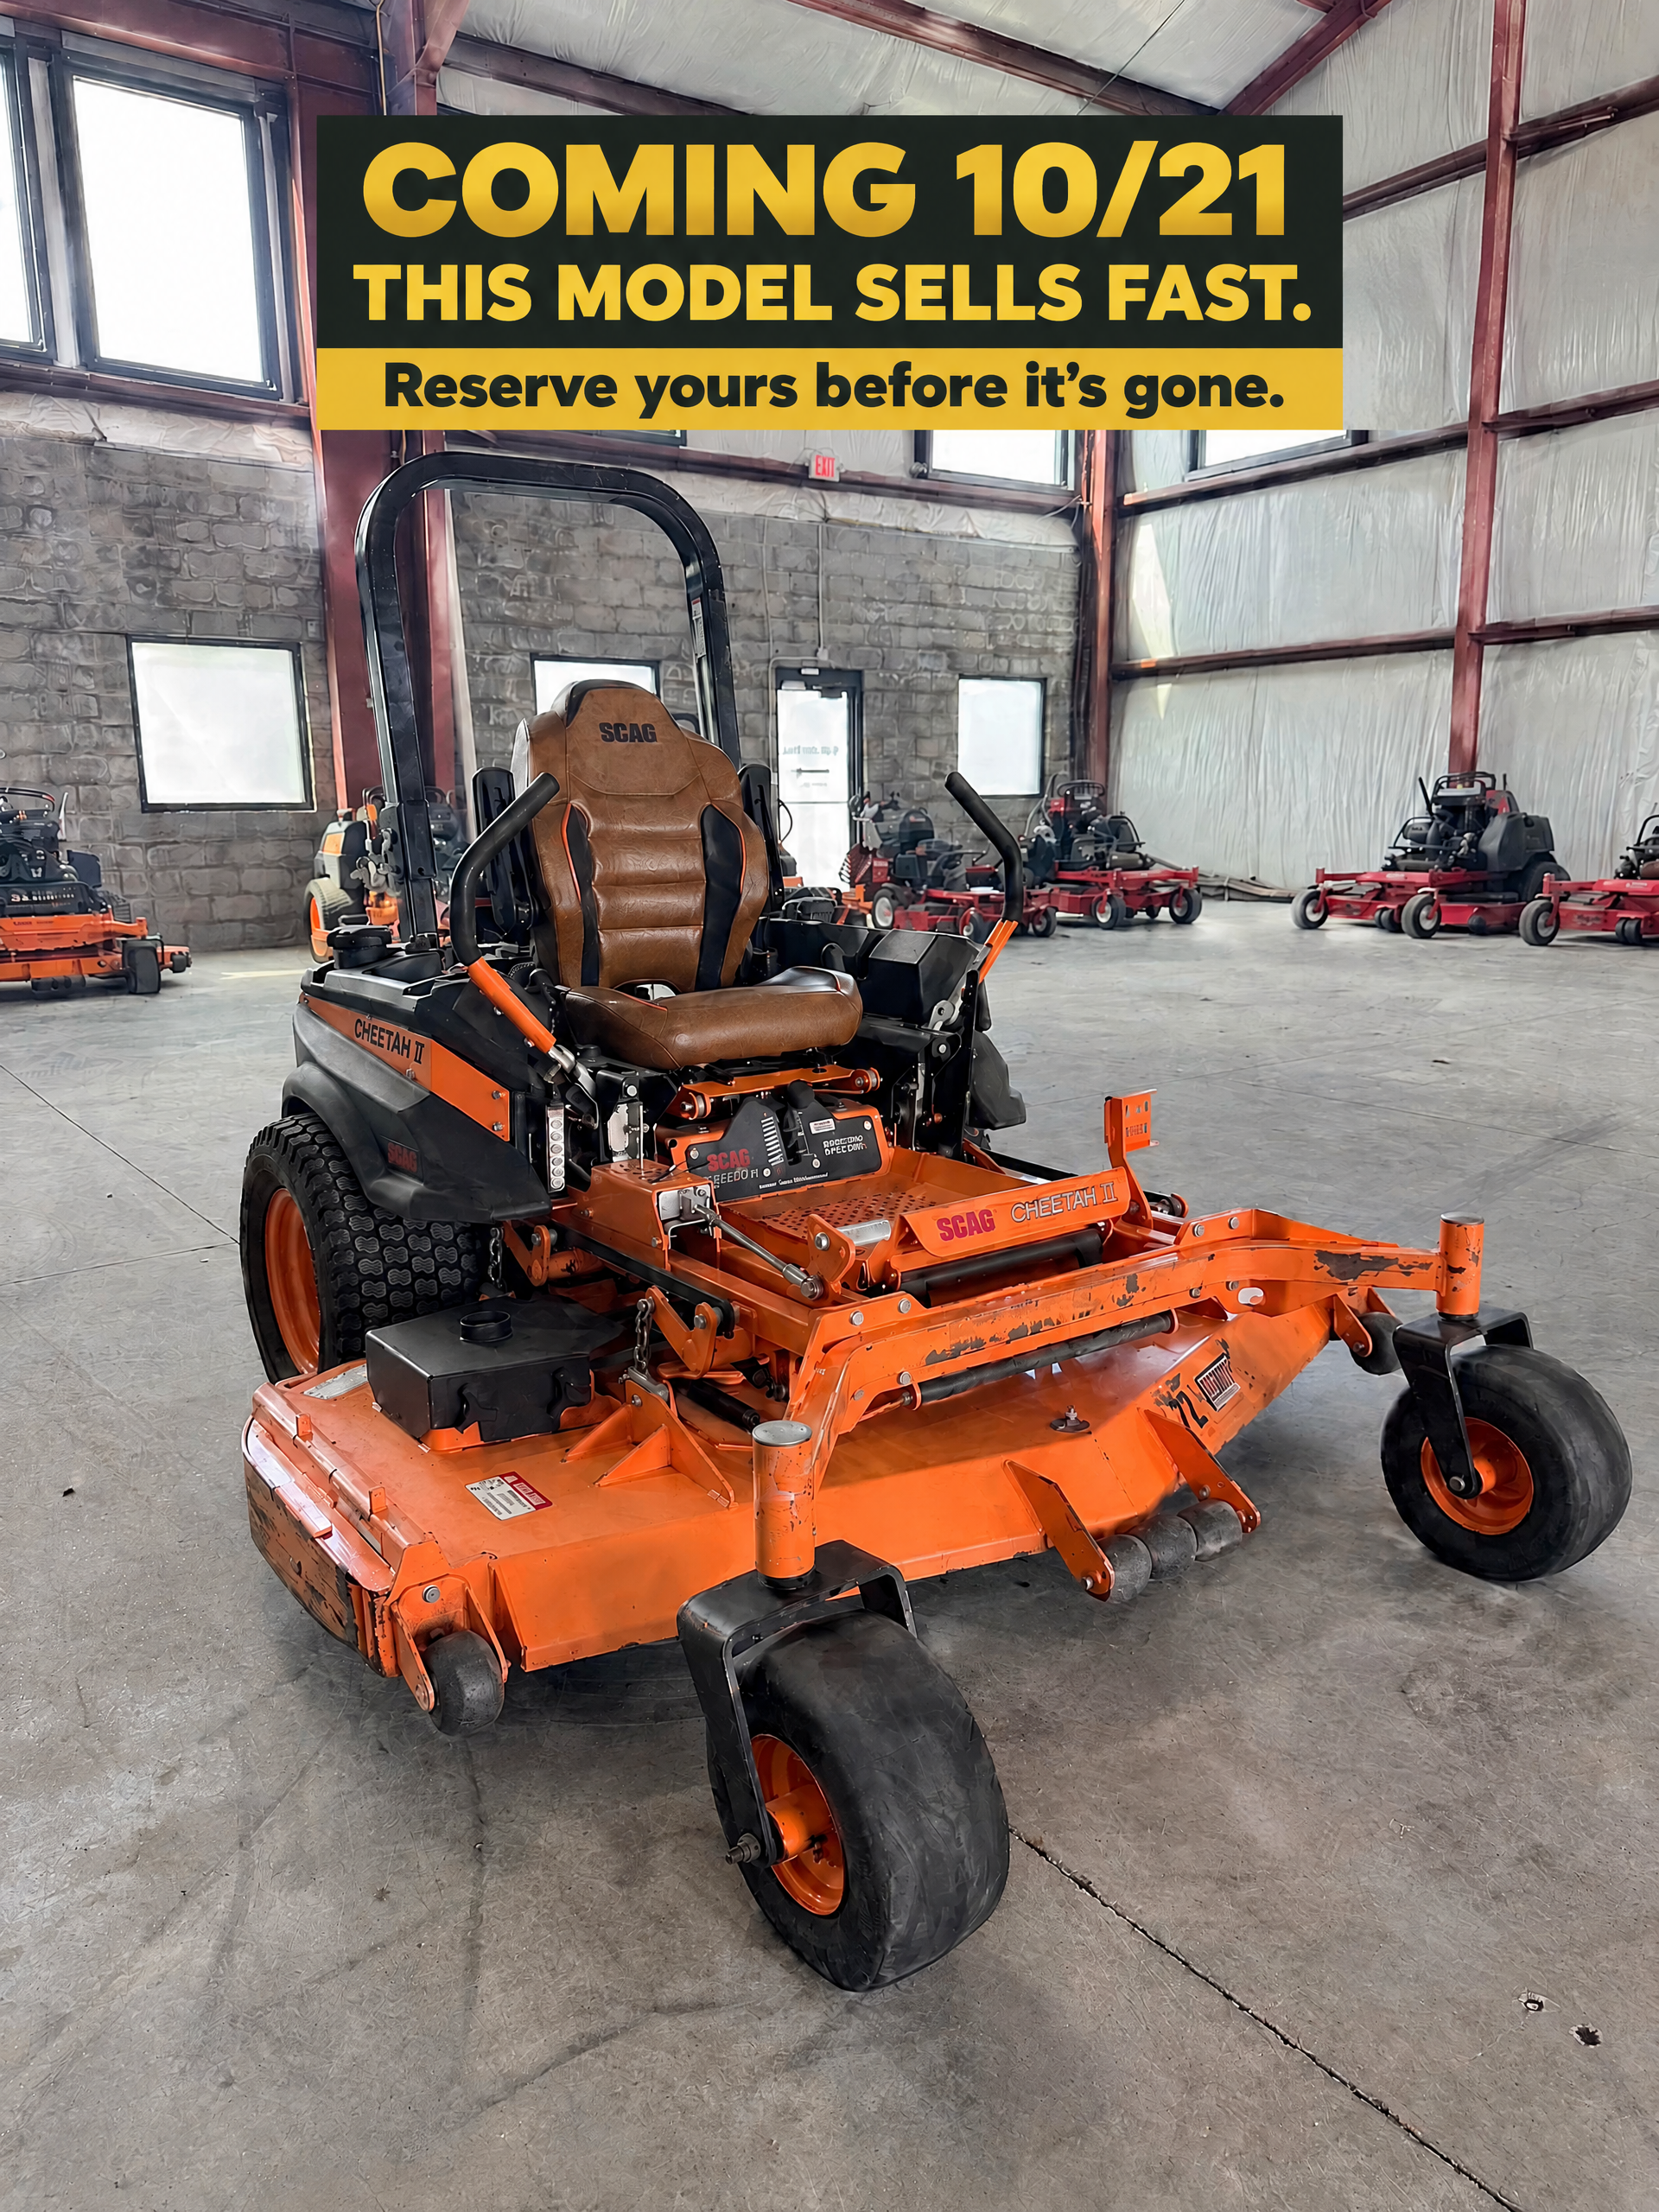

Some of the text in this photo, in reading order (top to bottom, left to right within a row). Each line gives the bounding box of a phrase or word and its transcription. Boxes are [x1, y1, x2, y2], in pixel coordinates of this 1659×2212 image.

[815, 454, 836, 478] EXIT
[599, 722, 658, 743] SCAG
[354, 1018, 425, 1065] CHEETAH II
[387, 1141, 417, 1173] SCAG
[707, 1148, 750, 1172] SCAG
[937, 1182, 1118, 1242] SCAG CHEETAH II
